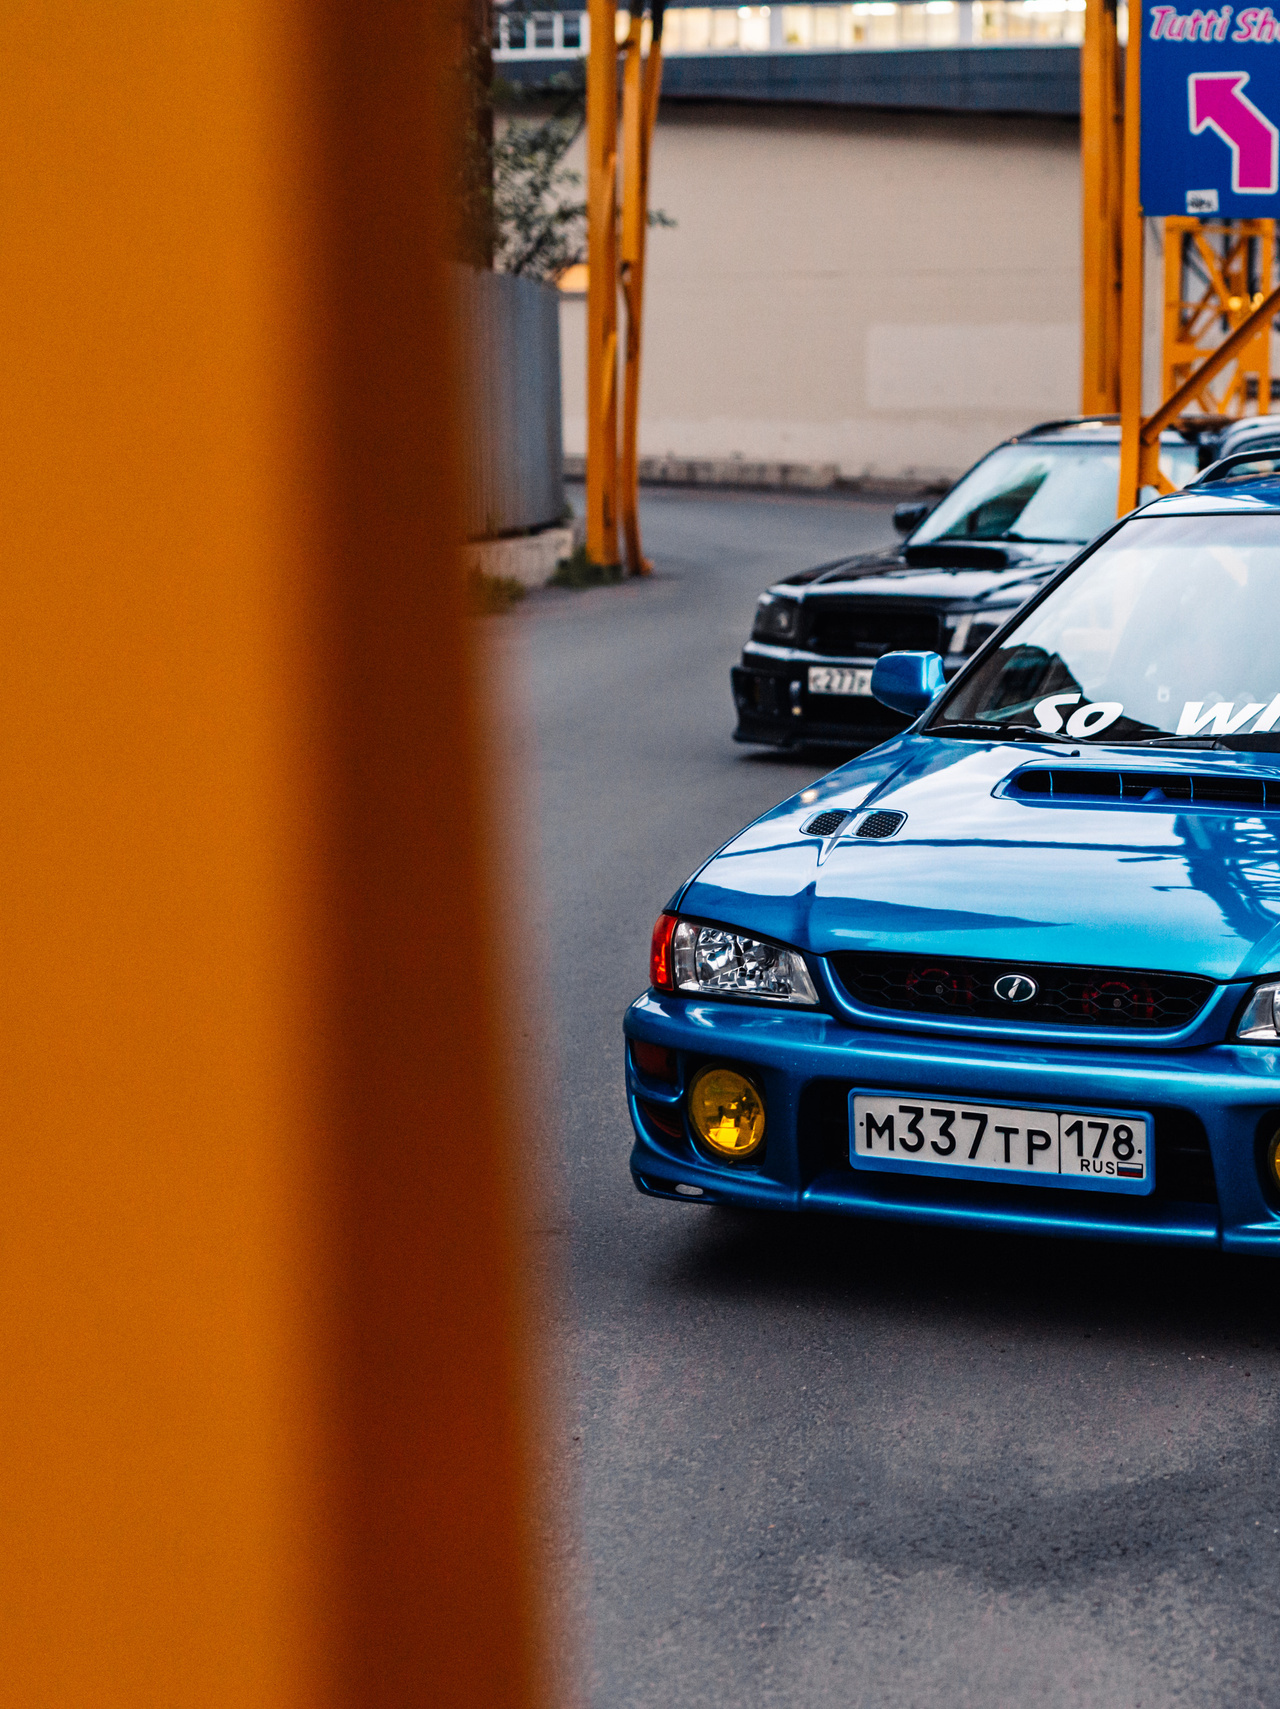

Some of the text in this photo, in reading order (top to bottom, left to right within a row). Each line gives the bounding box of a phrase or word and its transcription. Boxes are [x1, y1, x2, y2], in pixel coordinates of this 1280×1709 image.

[1150, 5, 1233, 41] Tutti
[1032, 693, 1124, 738] So
[1064, 1120, 1135, 1161] 178
[1080, 1159, 1115, 1175] RUS
